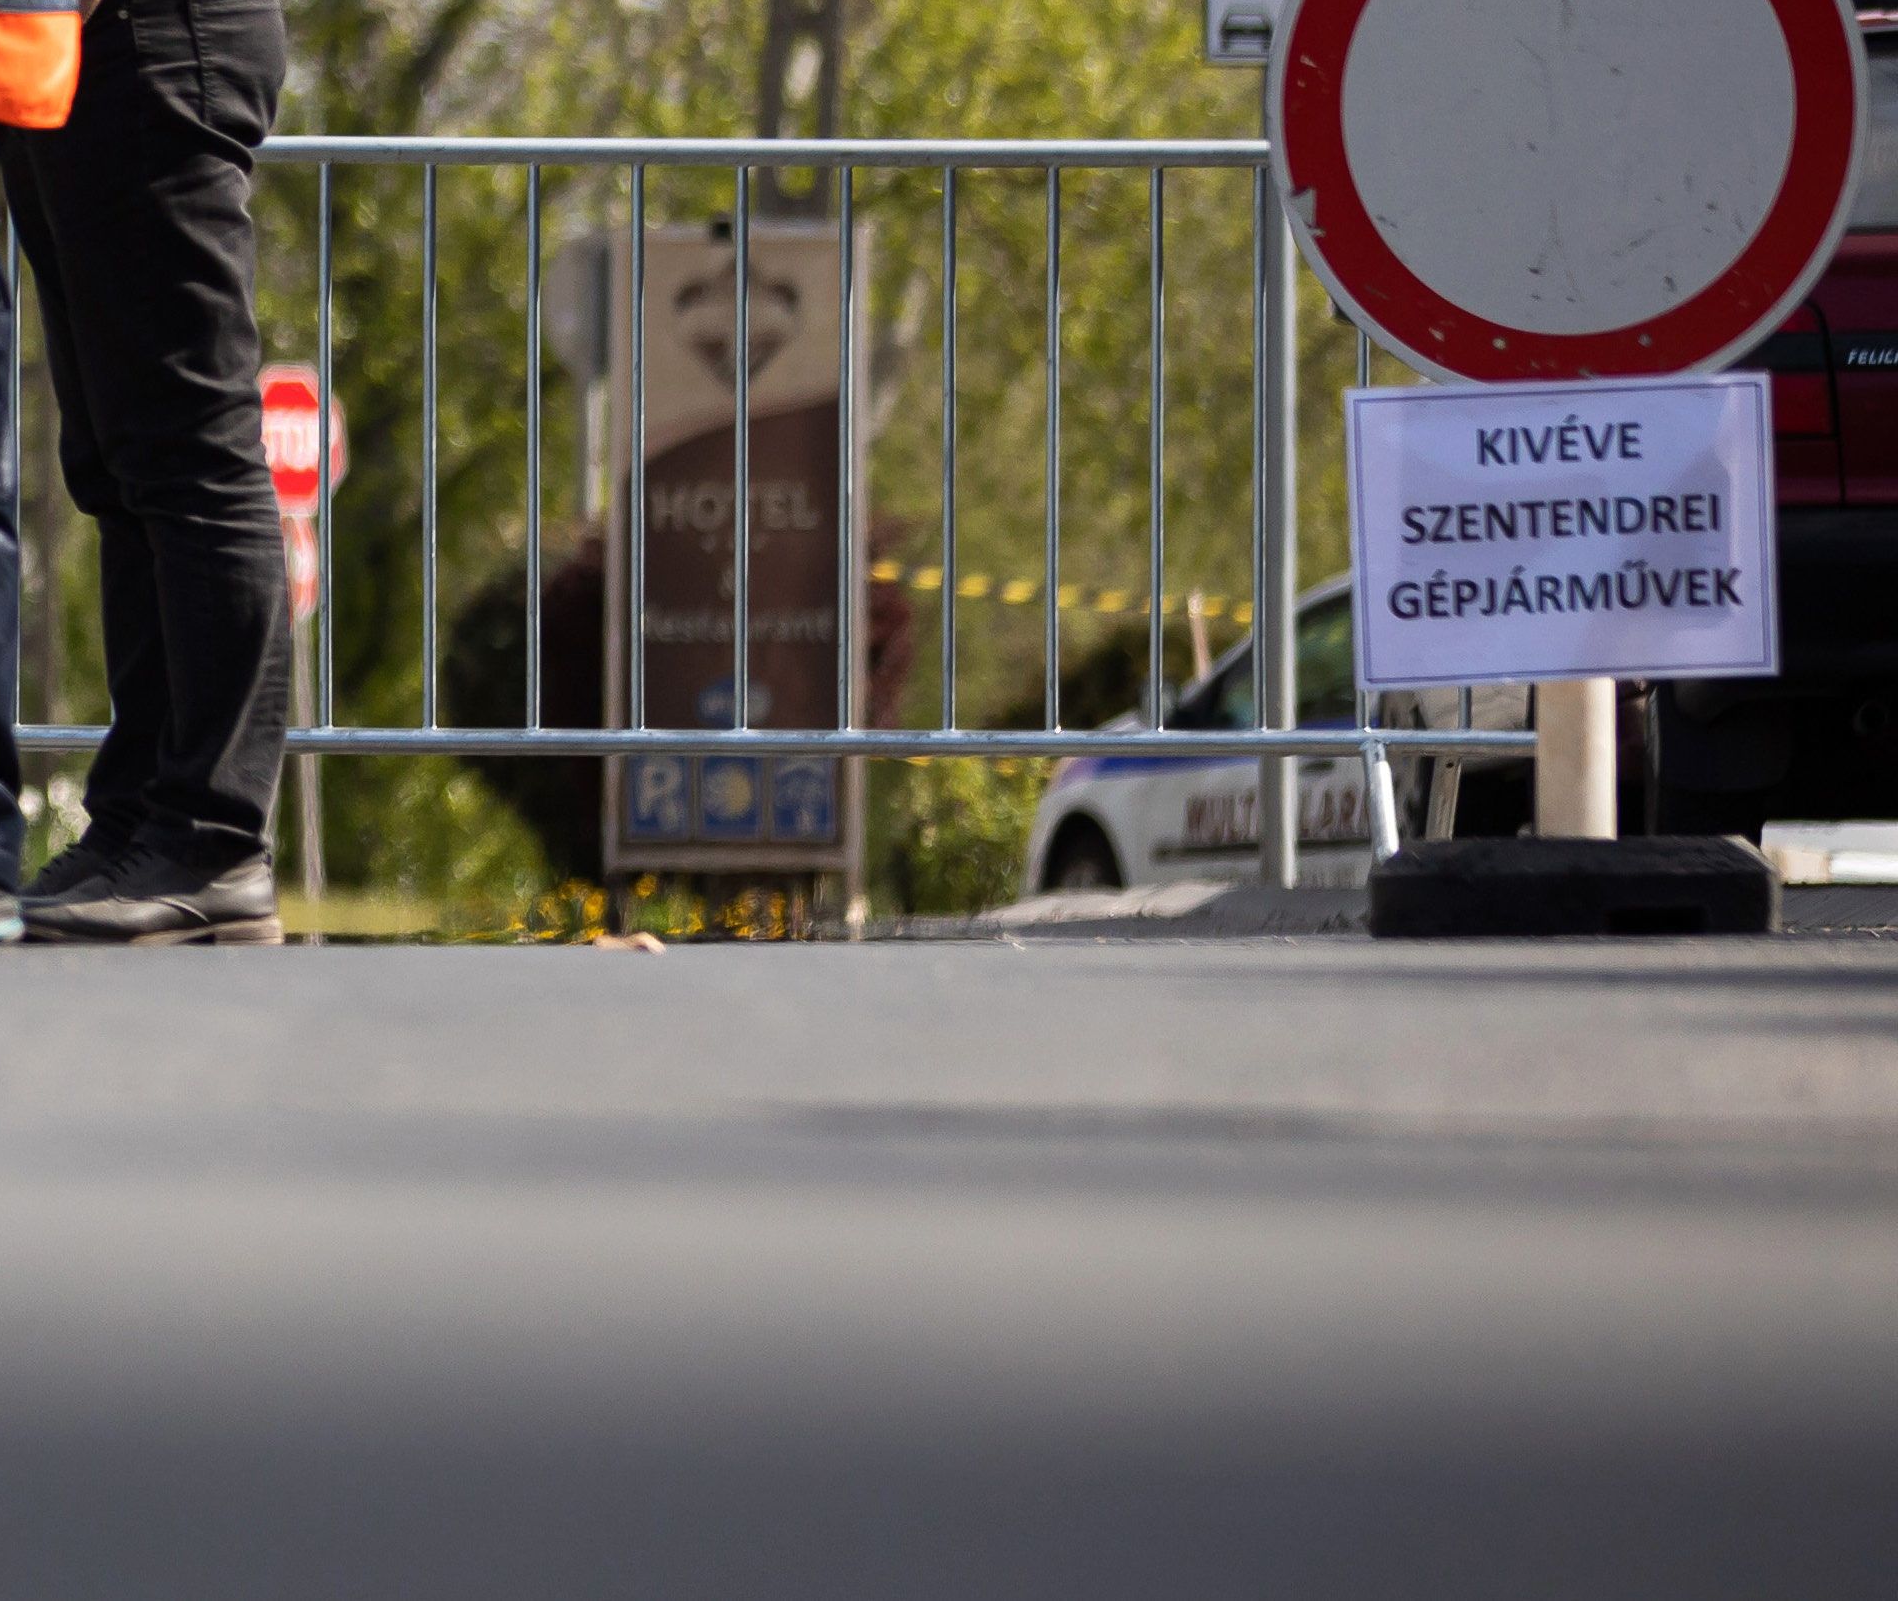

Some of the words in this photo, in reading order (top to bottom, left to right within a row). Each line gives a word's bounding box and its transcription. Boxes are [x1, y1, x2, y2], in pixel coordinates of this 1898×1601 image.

[1475, 414, 1642, 466] KIVÉVE
[1401, 493, 1721, 544] SZENTENDREI
[1386, 559, 1743, 620] GÉPJÁRMŰVEK
